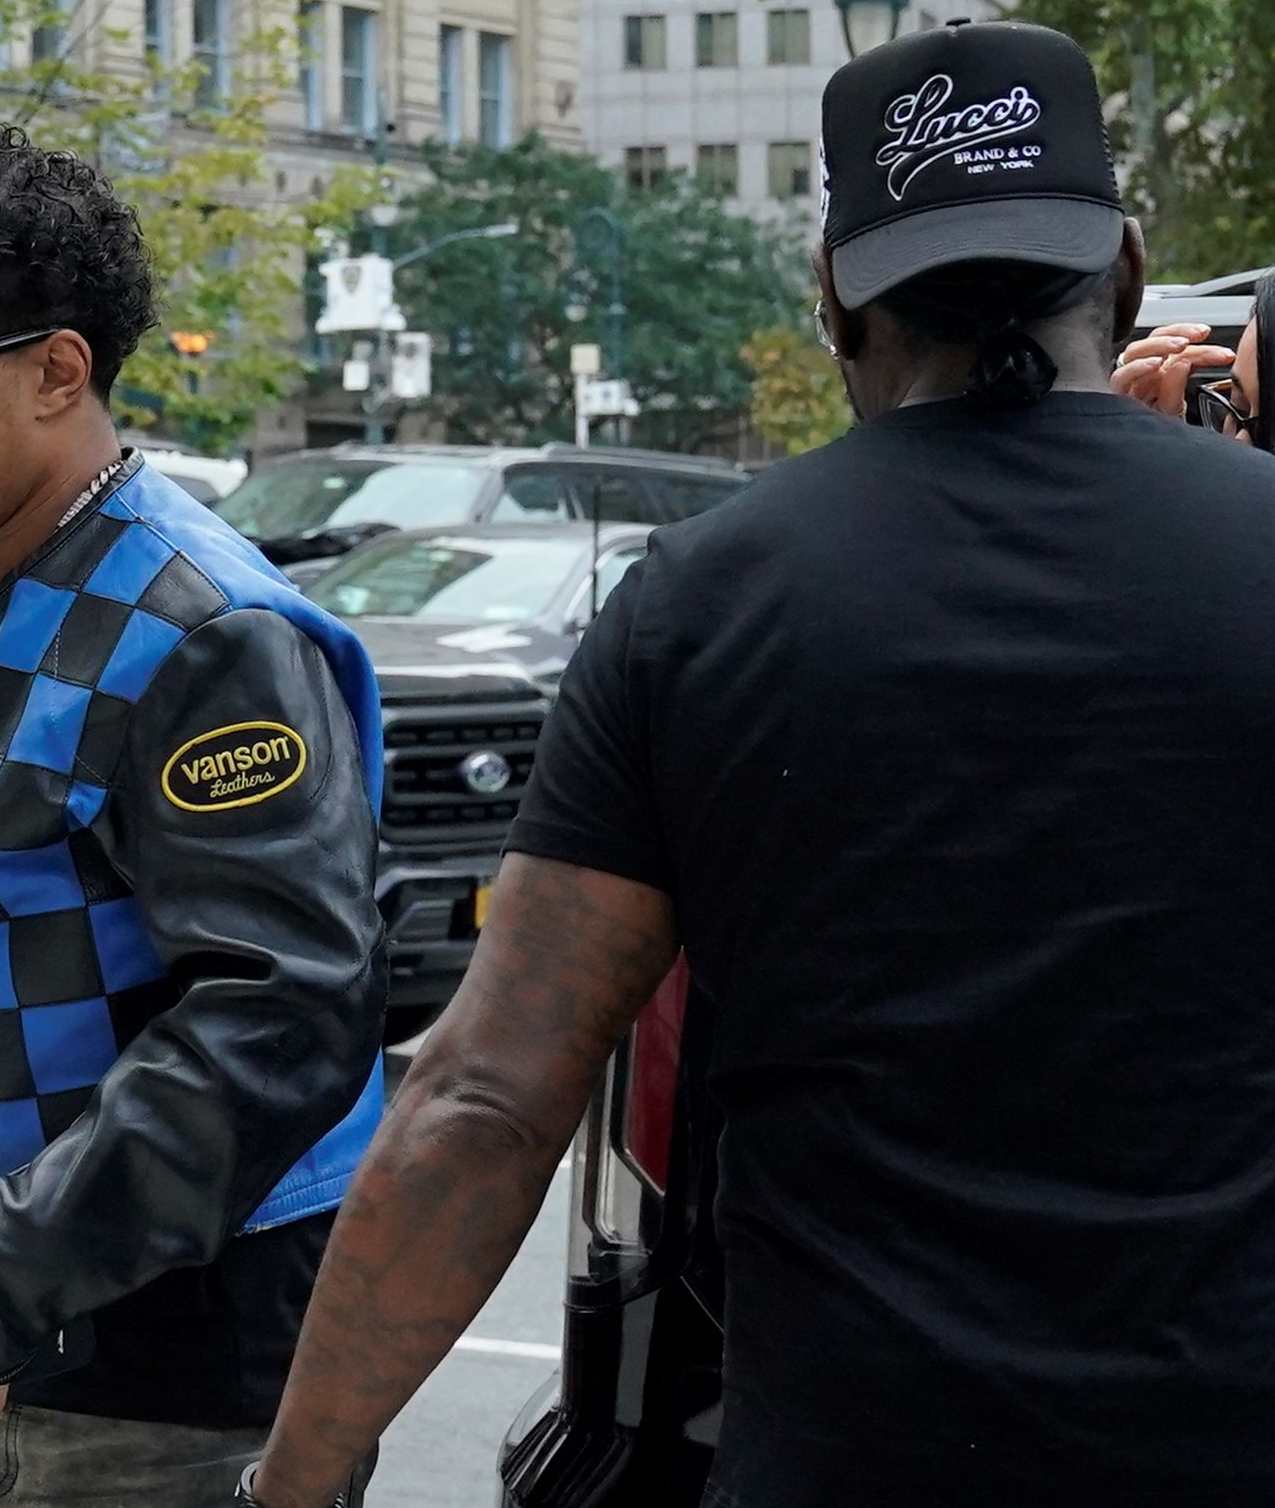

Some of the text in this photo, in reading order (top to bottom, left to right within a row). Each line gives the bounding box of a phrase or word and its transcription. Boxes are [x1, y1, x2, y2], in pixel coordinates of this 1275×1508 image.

[953, 145, 1042, 165] BRAND & CO
[967, 159, 1034, 174] NEW YORK
[209, 771, 276, 798] Leathers
